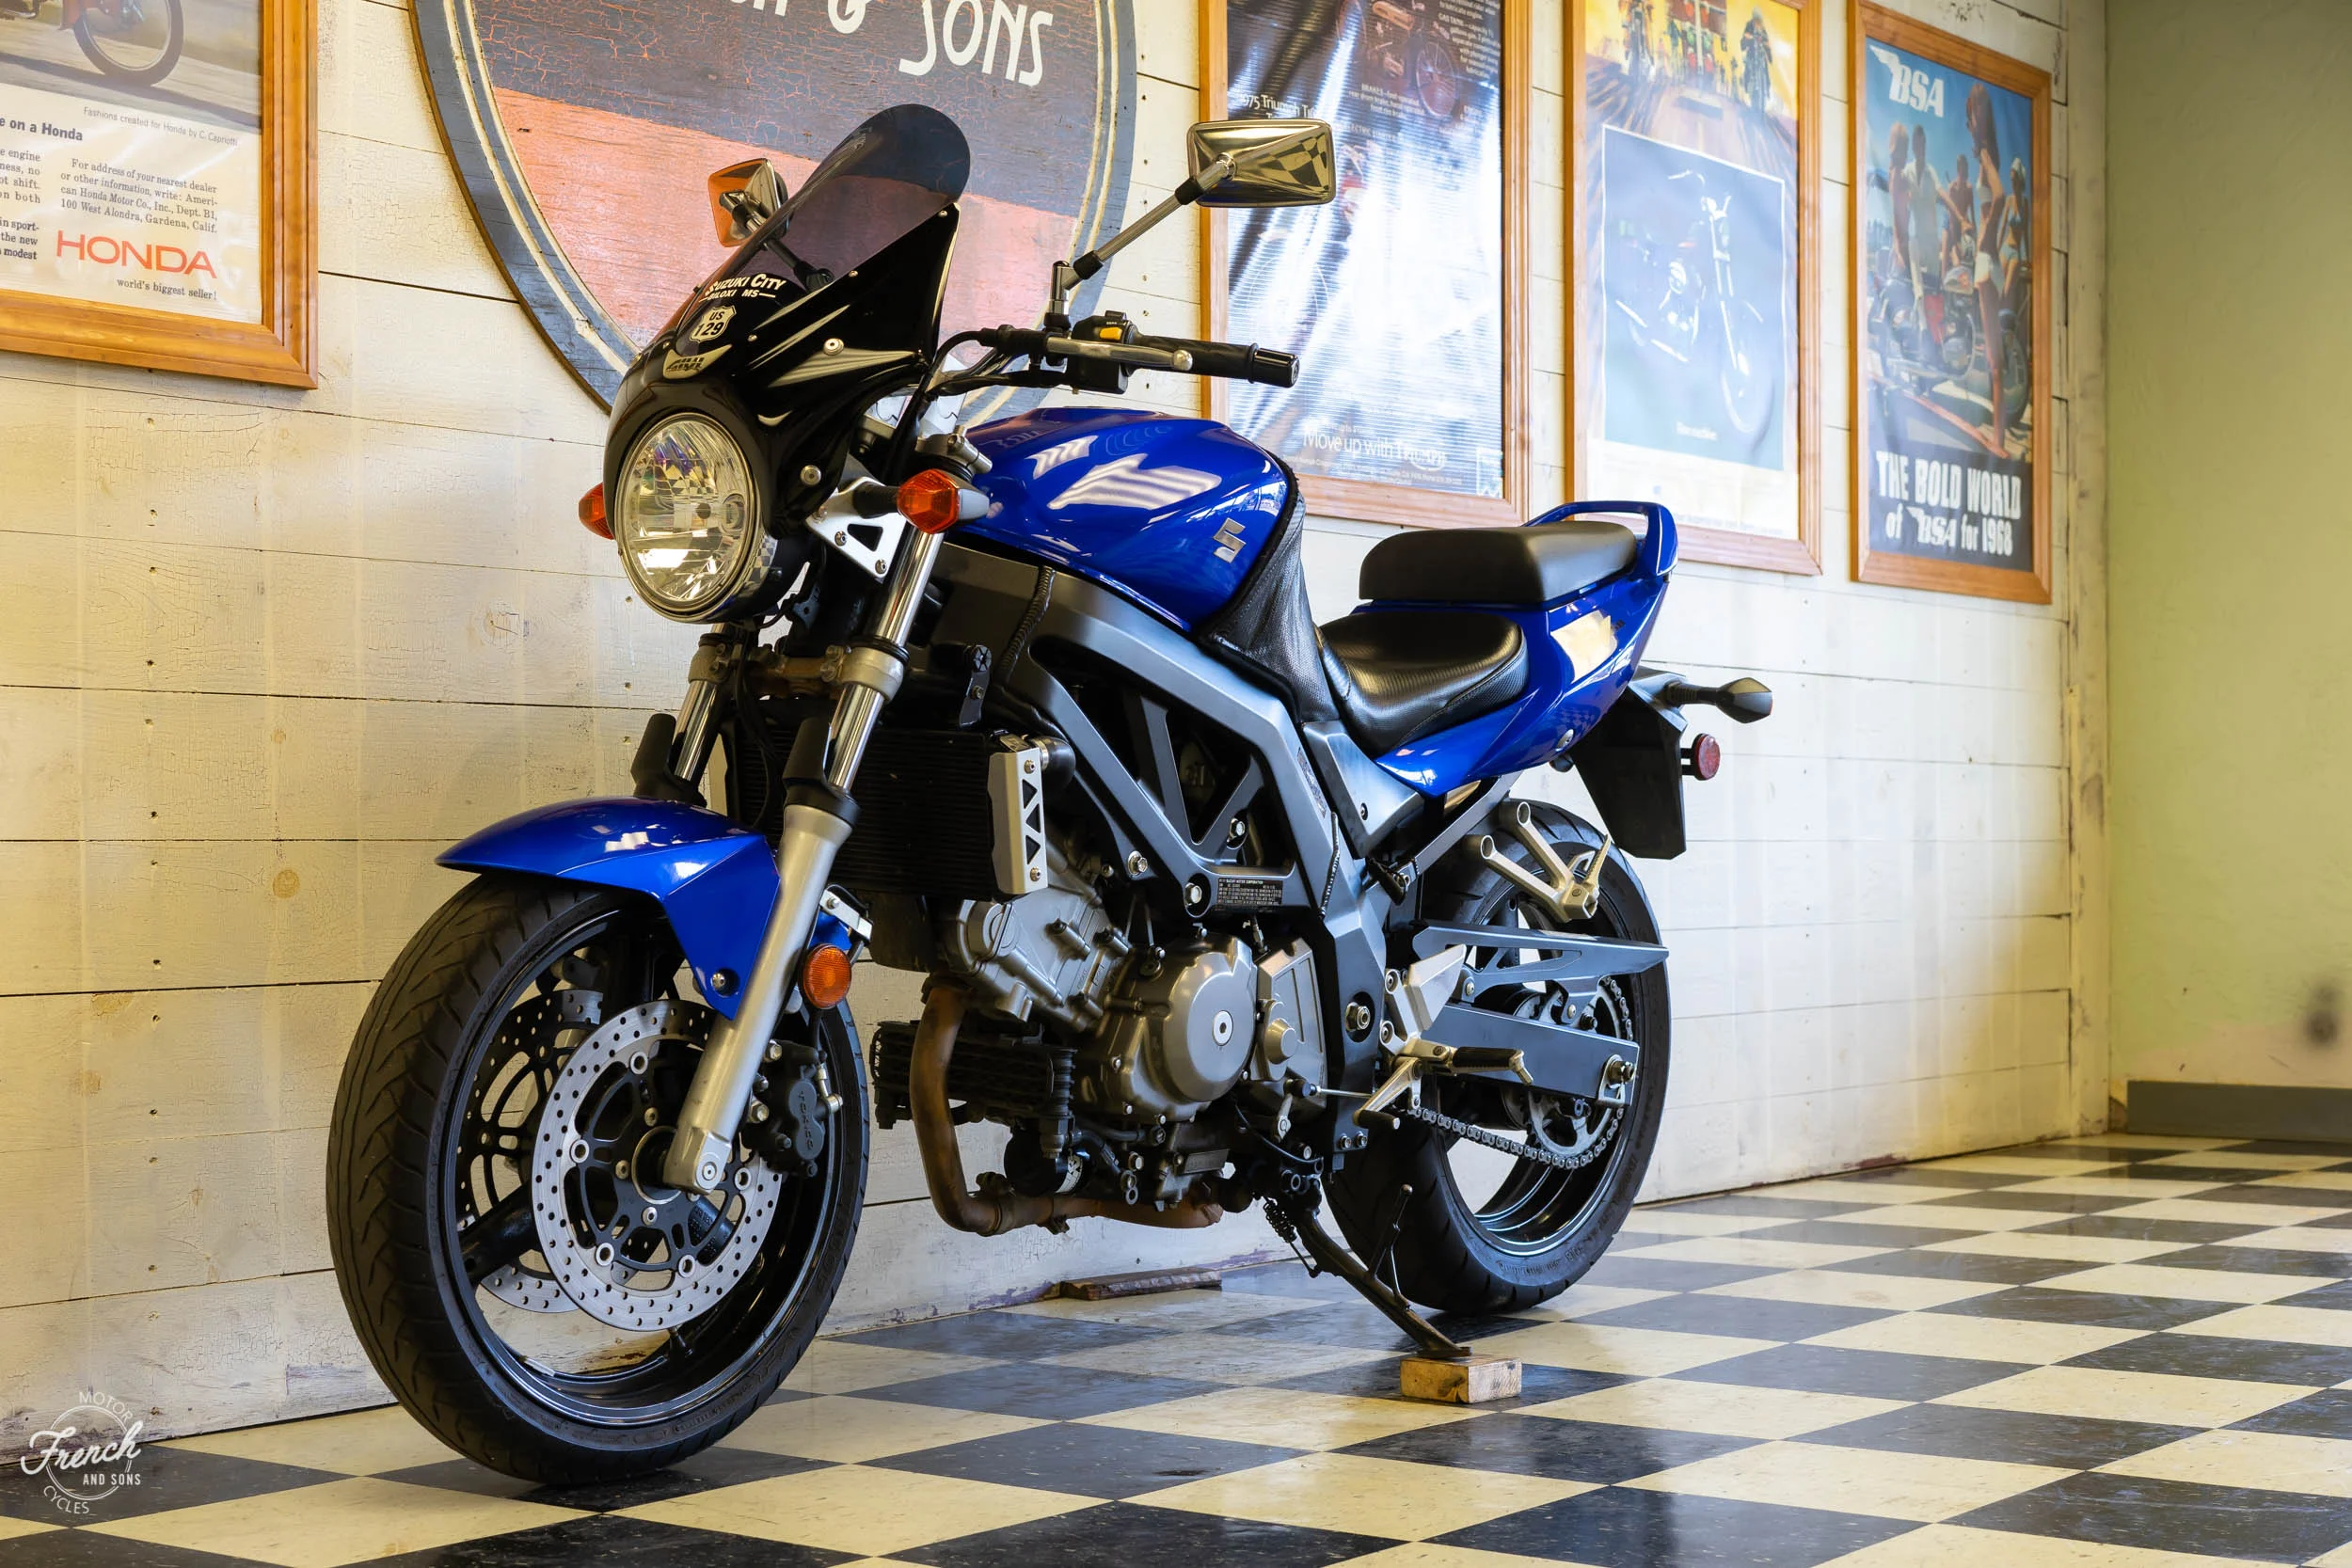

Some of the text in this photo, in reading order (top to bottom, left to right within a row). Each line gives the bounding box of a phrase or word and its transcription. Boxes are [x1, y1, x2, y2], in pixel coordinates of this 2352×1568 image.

[1887, 60, 1945, 118] BSA
[9, 119, 25, 131] on
[29, 123, 37, 133] a
[41, 122, 83, 141] Honda
[83, 106, 118, 121] Fashions
[119, 114, 149, 128] created
[151, 119, 161, 129] for
[163, 122, 186, 136] Honda
[188, 128, 197, 138] by
[199, 130, 207, 140] C.
[8, 150, 41, 162] engine
[72, 158, 217, 194] For address of your nearest dealer
[15, 190, 40, 203] both
[60, 171, 218, 206] or other information, write: Ameri-
[60, 185, 77, 196] can
[80, 186, 107, 202] Honda
[109, 193, 135, 207] Motor
[154, 200, 174, 214] Inc.,
[176, 205, 201, 218] Dept.
[203, 209, 218, 221] B1,
[10, 219, 40, 231] sport-
[60, 198, 218, 233] 100 West Alondra, Gardena, Calif.
[1, 231, 39, 245] the new
[4, 246, 38, 260] modest
[56, 230, 217, 279] HONDA
[117, 278, 217, 301] world's biggest seller!
[705, 277, 751, 296] SUZUKI
[741, 289, 760, 298] MS
[708, 311, 724, 321] US
[694, 322, 724, 337] 129
[1303, 428, 1343, 451] Move
[1343, 436, 1363, 459] up
[1364, 436, 1393, 460] with
[1876, 451, 2022, 520] THE BOLD WORLD
[1885, 502, 2014, 557] of BSA for 1968
